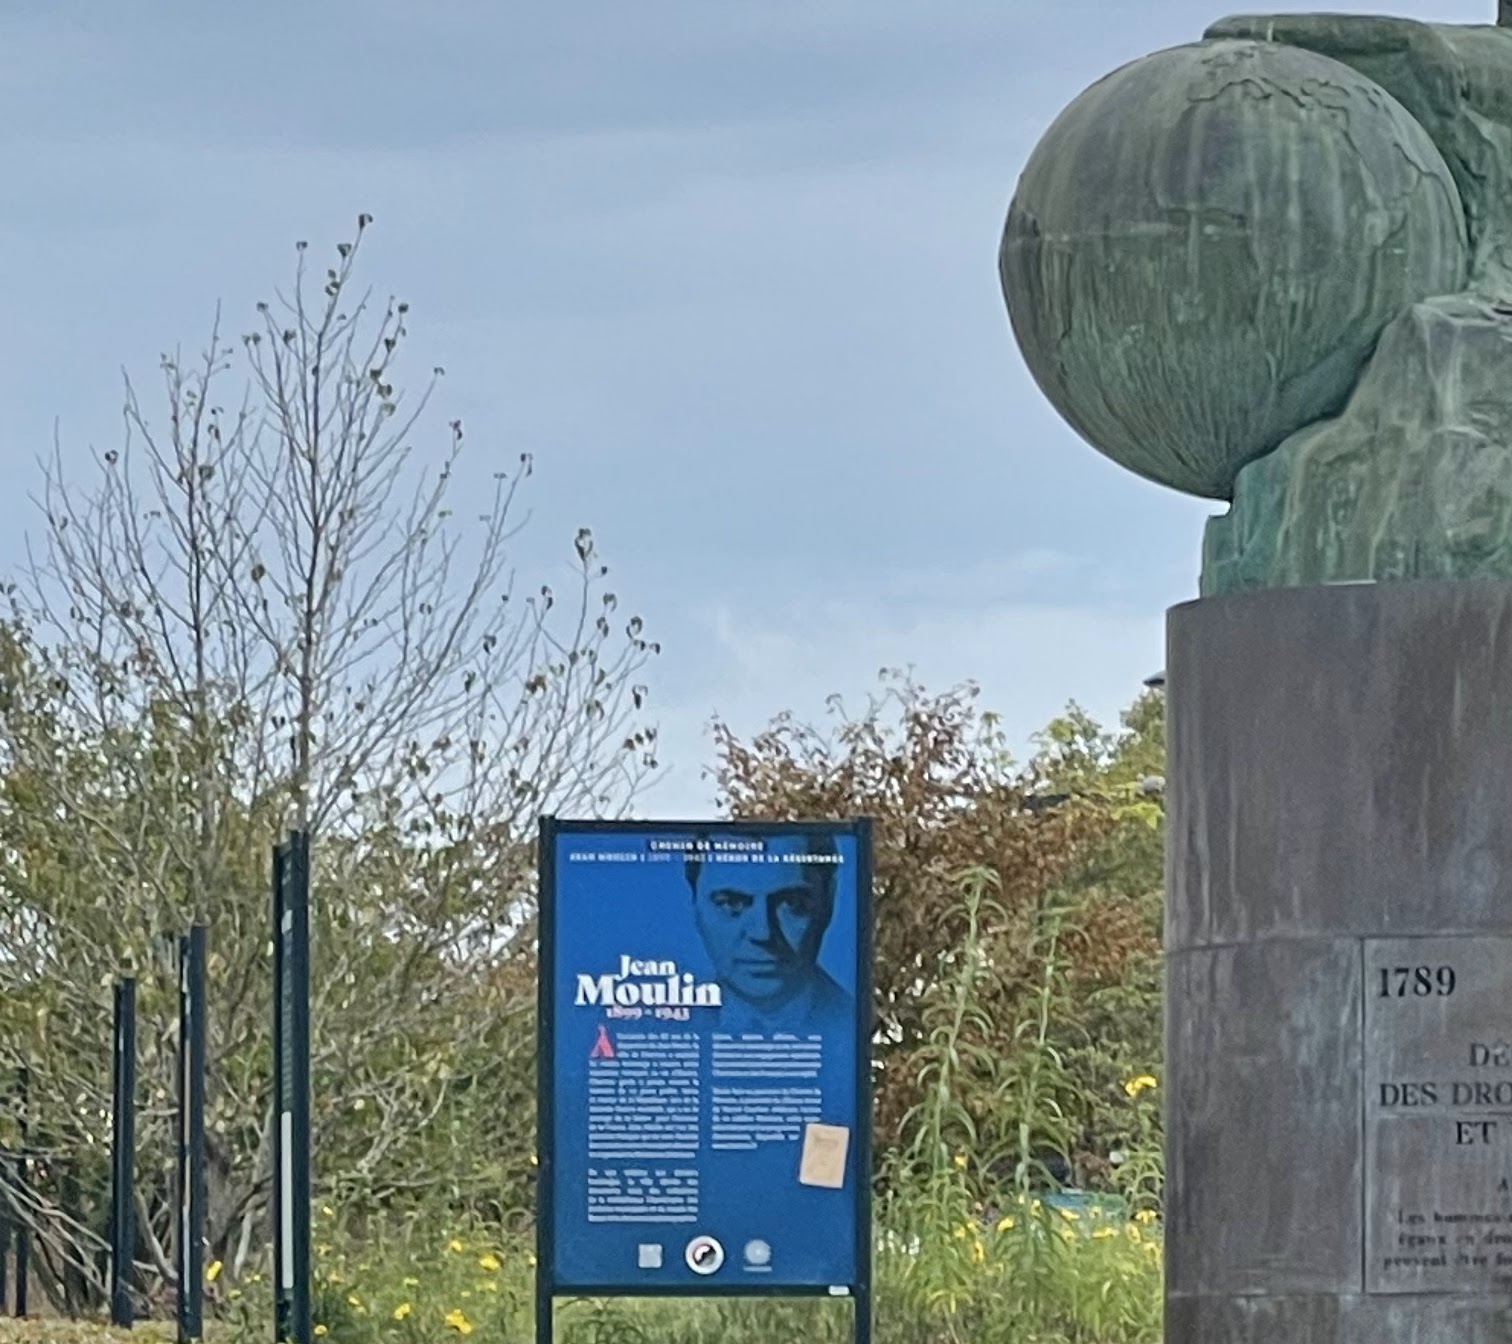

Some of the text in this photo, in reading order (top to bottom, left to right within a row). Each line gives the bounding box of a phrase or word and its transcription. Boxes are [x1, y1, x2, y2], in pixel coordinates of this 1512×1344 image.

[616, 954, 677, 981] Jean
[574, 973, 722, 1006] Moulin
[1376, 965, 1457, 999] 1789
[1379, 1082, 1439, 1108] DES
[1455, 1121, 1497, 1146] ET
